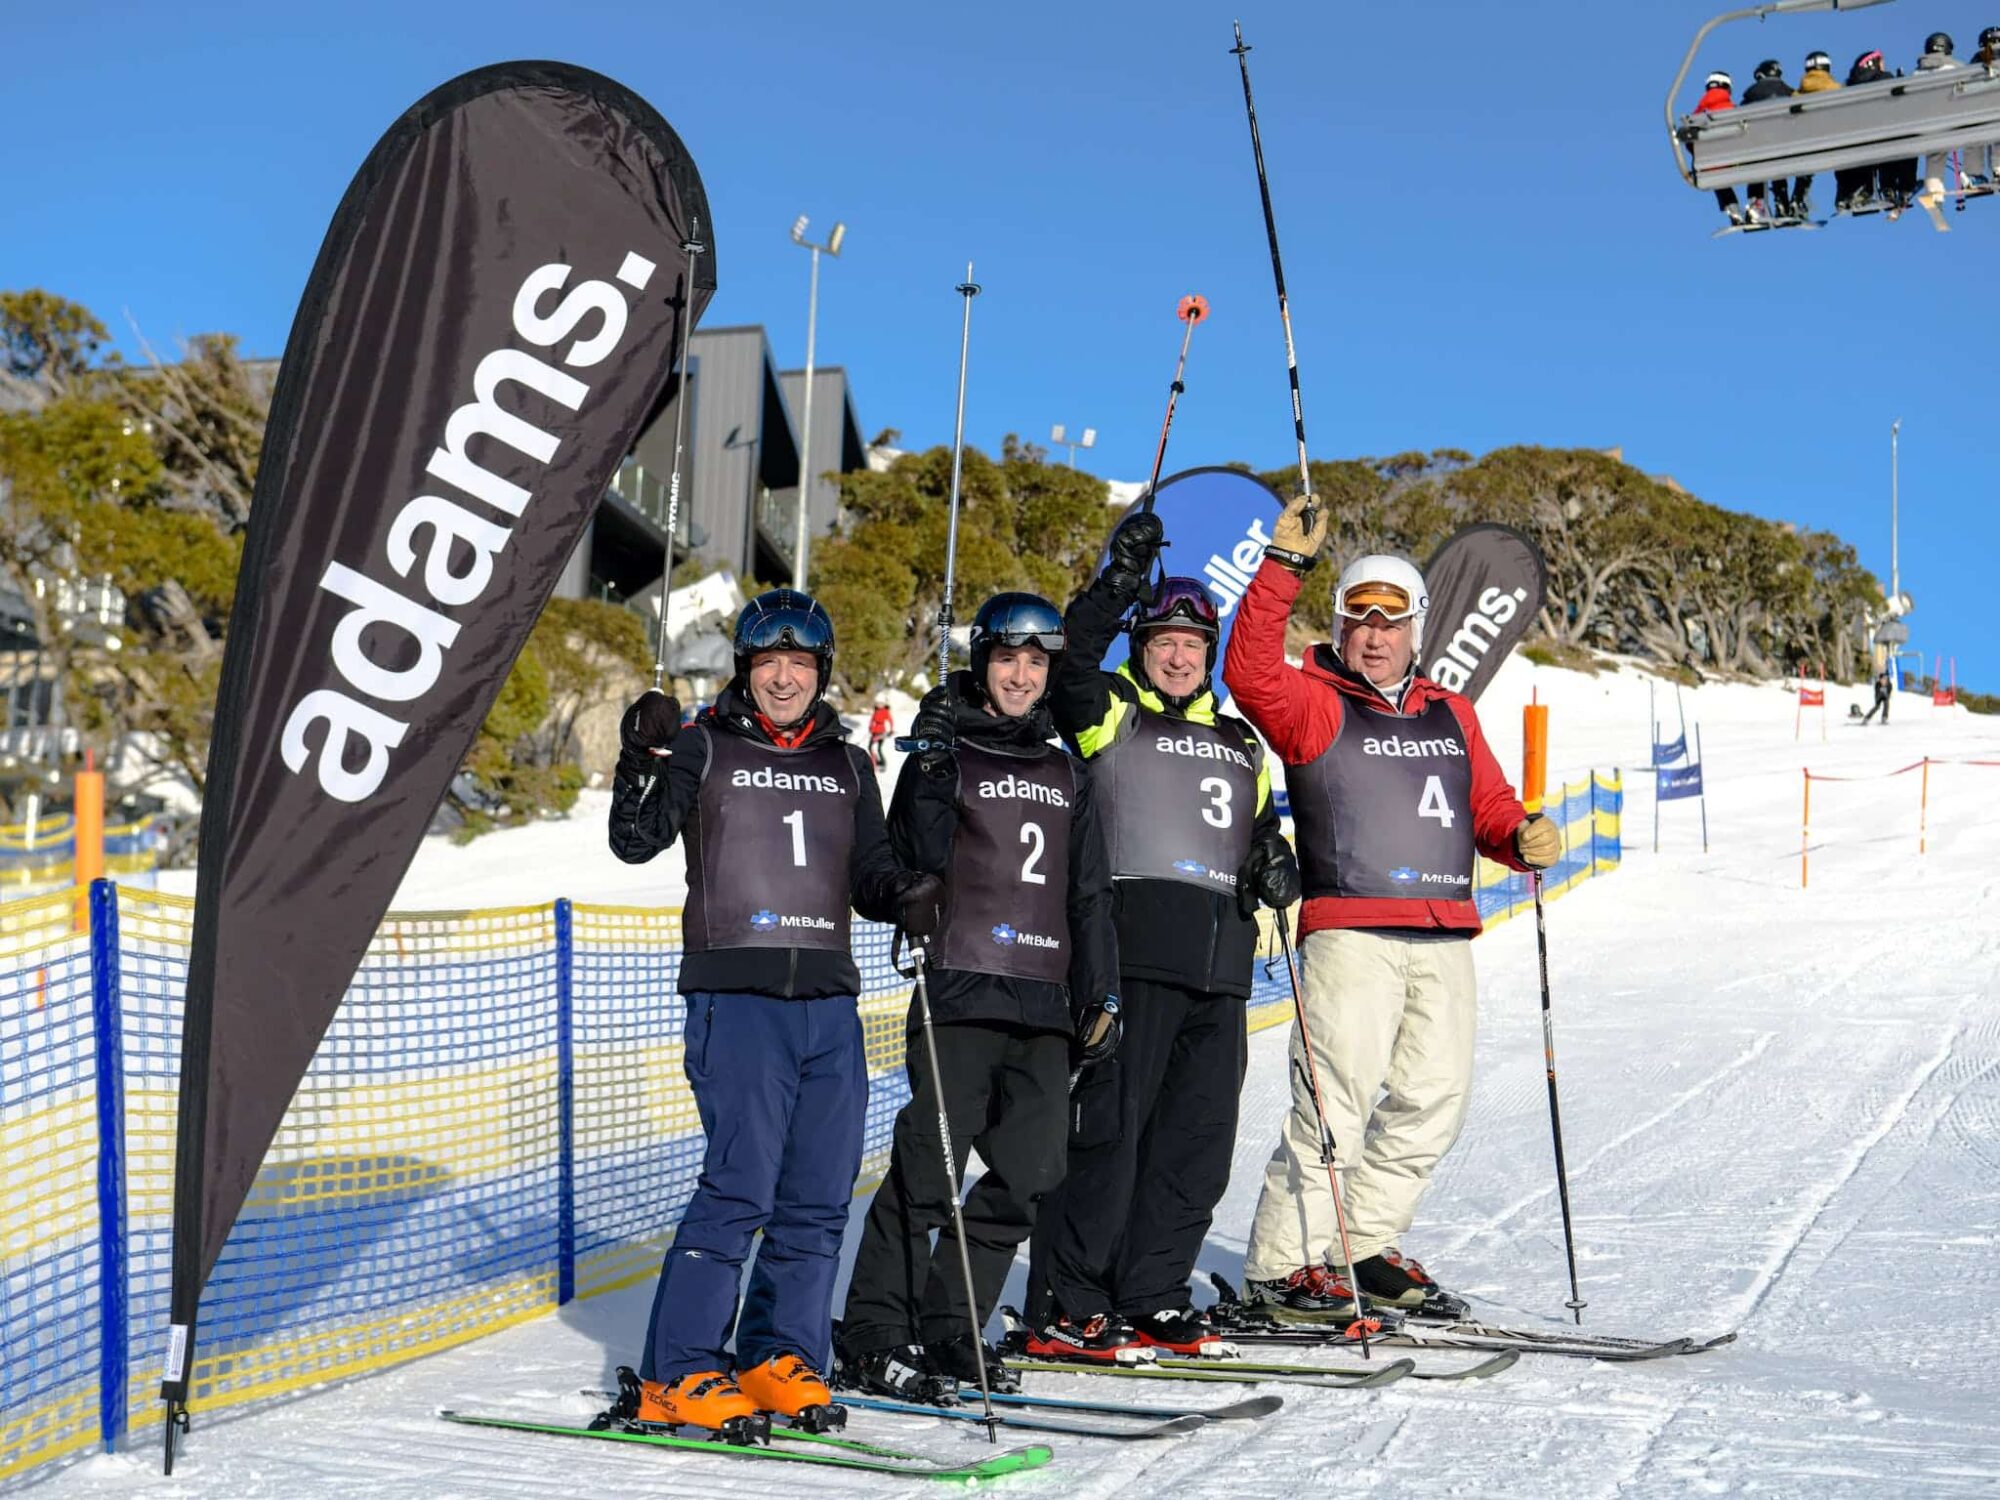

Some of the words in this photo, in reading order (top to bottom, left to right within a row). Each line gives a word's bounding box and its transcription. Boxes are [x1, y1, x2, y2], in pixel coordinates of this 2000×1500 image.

[280, 250, 657, 803] adams.
[668, 471, 681, 534] ATOMIC
[1203, 518, 1272, 617] uller
[1430, 586, 1528, 693] ams.
[1156, 735, 1253, 770] adams.
[1363, 735, 1465, 758] adams.
[732, 766, 845, 795] adams.
[979, 774, 1069, 808] adams.
[1200, 776, 1232, 829] 3
[1418, 775, 1454, 828] 4
[783, 810, 807, 866] 1
[1020, 822, 1045, 884] 2
[1044, 1325, 1085, 1348] NORDICA
[646, 1390, 677, 1413] TECNICA
